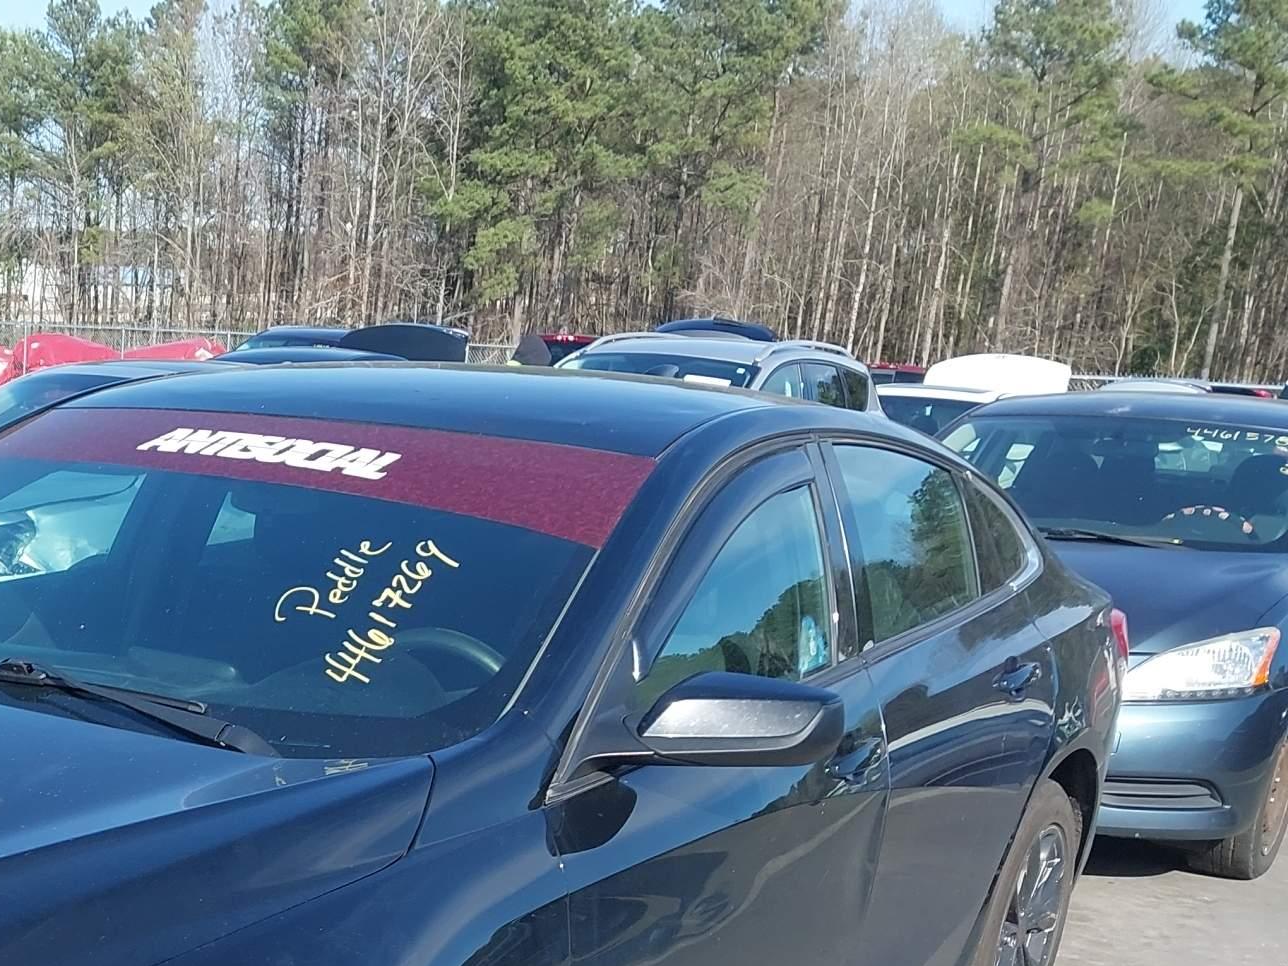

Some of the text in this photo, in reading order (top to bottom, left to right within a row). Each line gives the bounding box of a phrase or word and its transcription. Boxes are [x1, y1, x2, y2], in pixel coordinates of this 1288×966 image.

[136, 428, 402, 480] ANTISOCIAL
[274, 540, 393, 622] Peddle
[324, 539, 460, 684] 44617269
